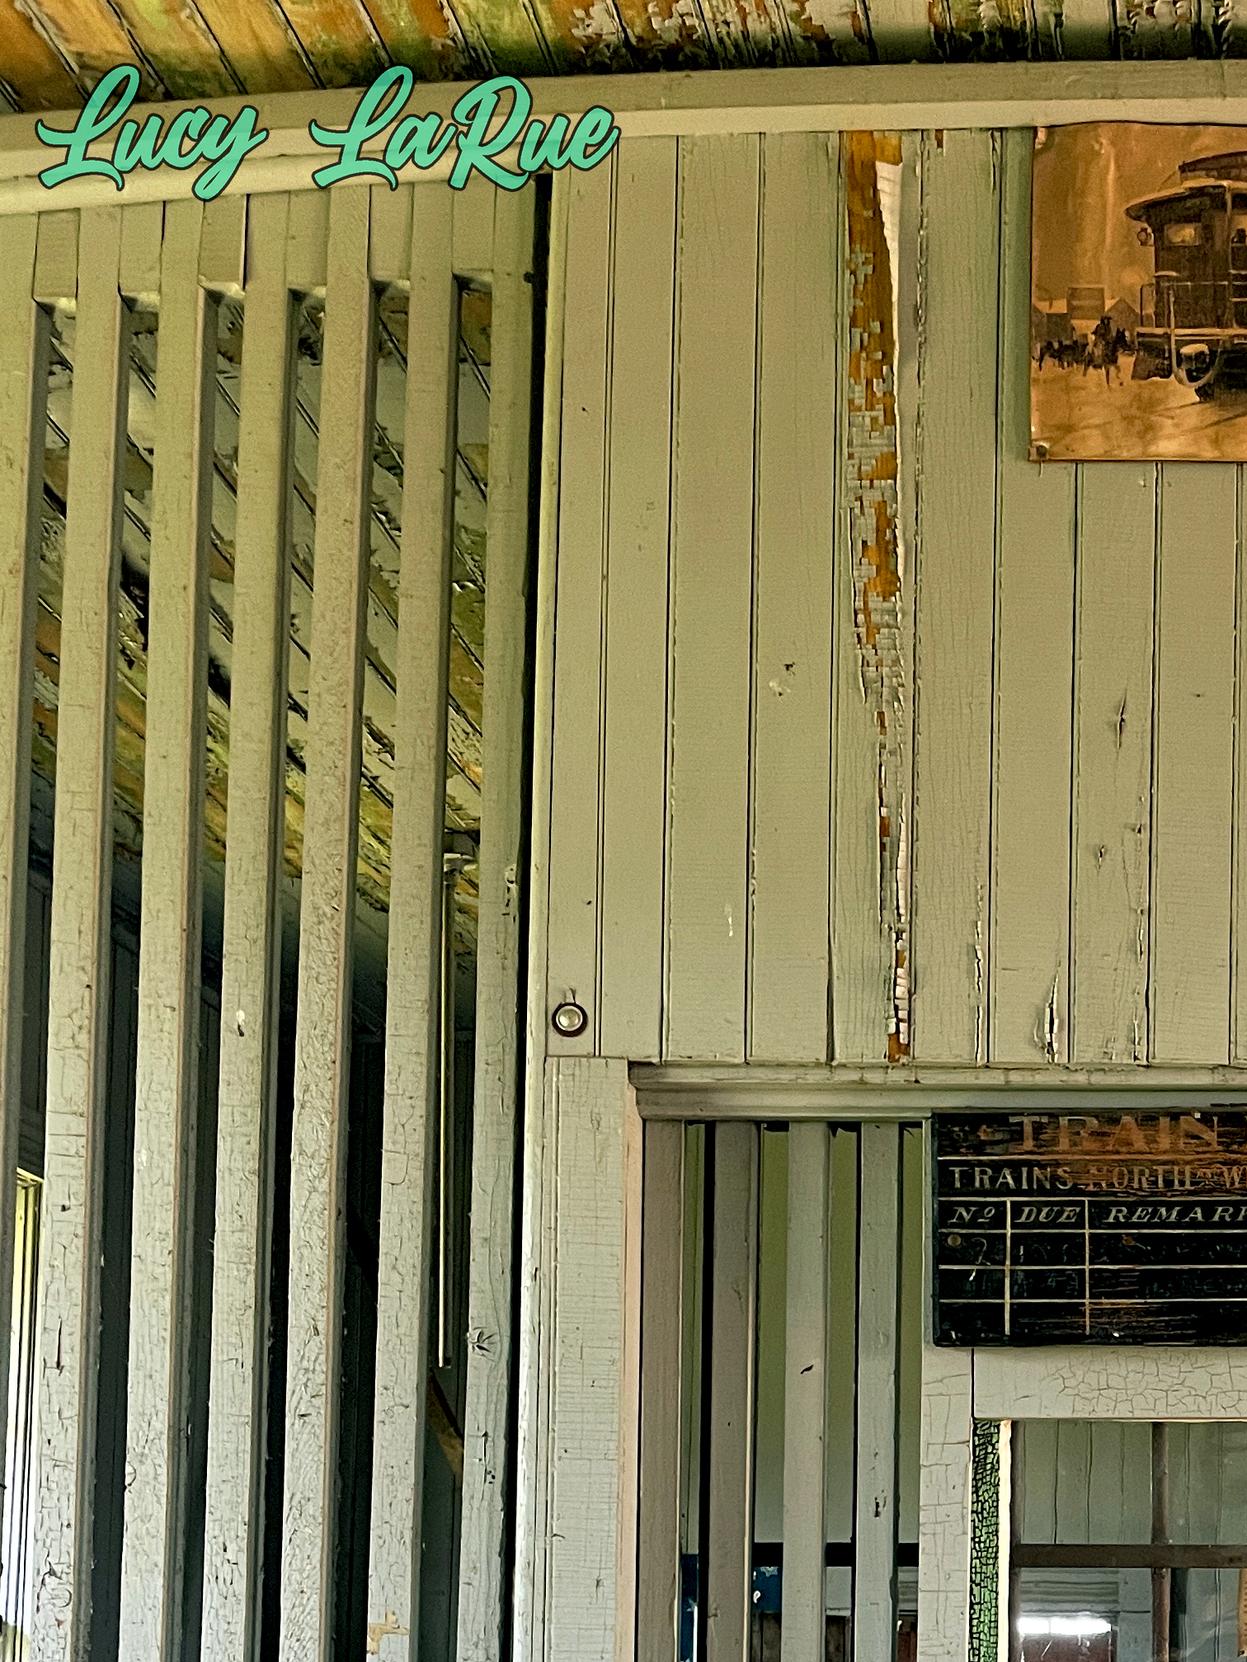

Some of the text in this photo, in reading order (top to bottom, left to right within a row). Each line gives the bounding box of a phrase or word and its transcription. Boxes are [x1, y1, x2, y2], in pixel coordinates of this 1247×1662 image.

[1008, 1114, 1218, 1150] TRAIN
[949, 1166, 1073, 1189] TRAINS
[1014, 1206, 1081, 1223] DUE
